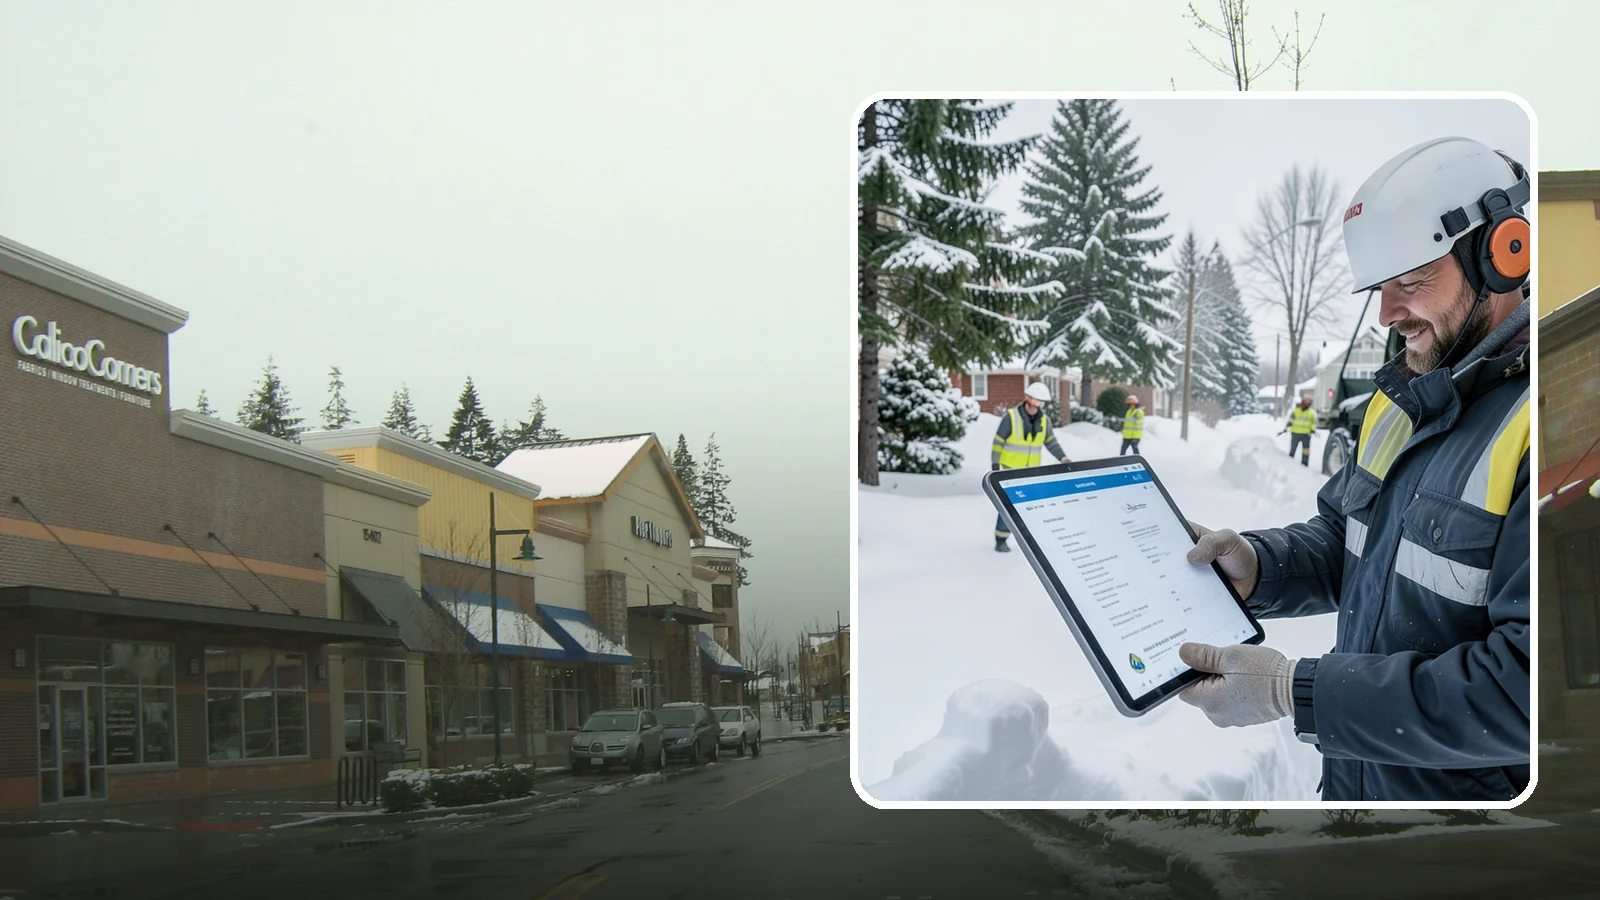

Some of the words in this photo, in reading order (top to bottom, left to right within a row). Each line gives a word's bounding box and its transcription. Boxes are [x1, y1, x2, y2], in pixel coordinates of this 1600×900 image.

[17, 360, 46, 377] FABRICS
[51, 370, 78, 386] WINDOW
[79, 378, 116, 398] TREATMENTS
[120, 390, 151, 408] FURNITURE
